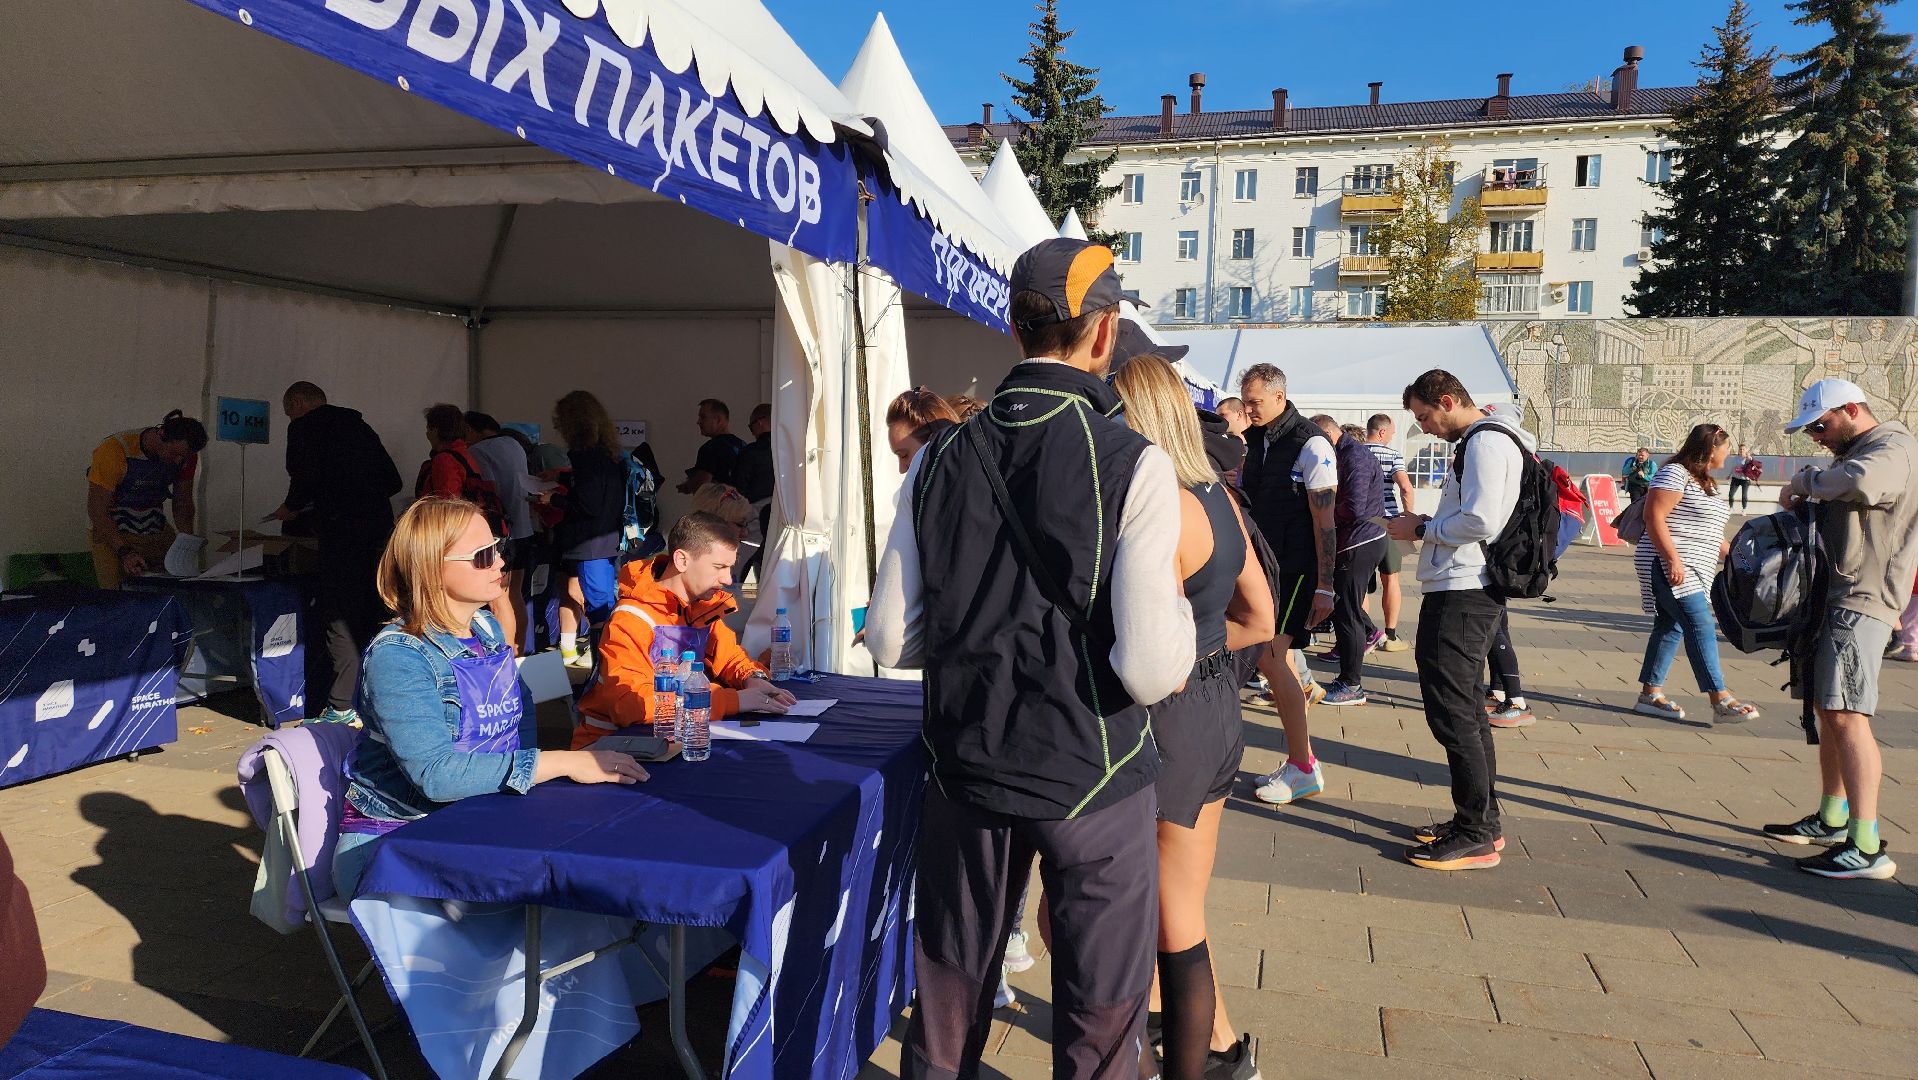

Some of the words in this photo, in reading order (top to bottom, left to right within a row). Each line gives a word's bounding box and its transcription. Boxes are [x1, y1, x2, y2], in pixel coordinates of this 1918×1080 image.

[575, 35, 822, 247] ПАКЕТОВ
[222, 410, 240, 426] 10
[131, 691, 161, 704] SPACE
[131, 697, 177, 712] MARATHO
[476, 697, 519, 719] SPACE
